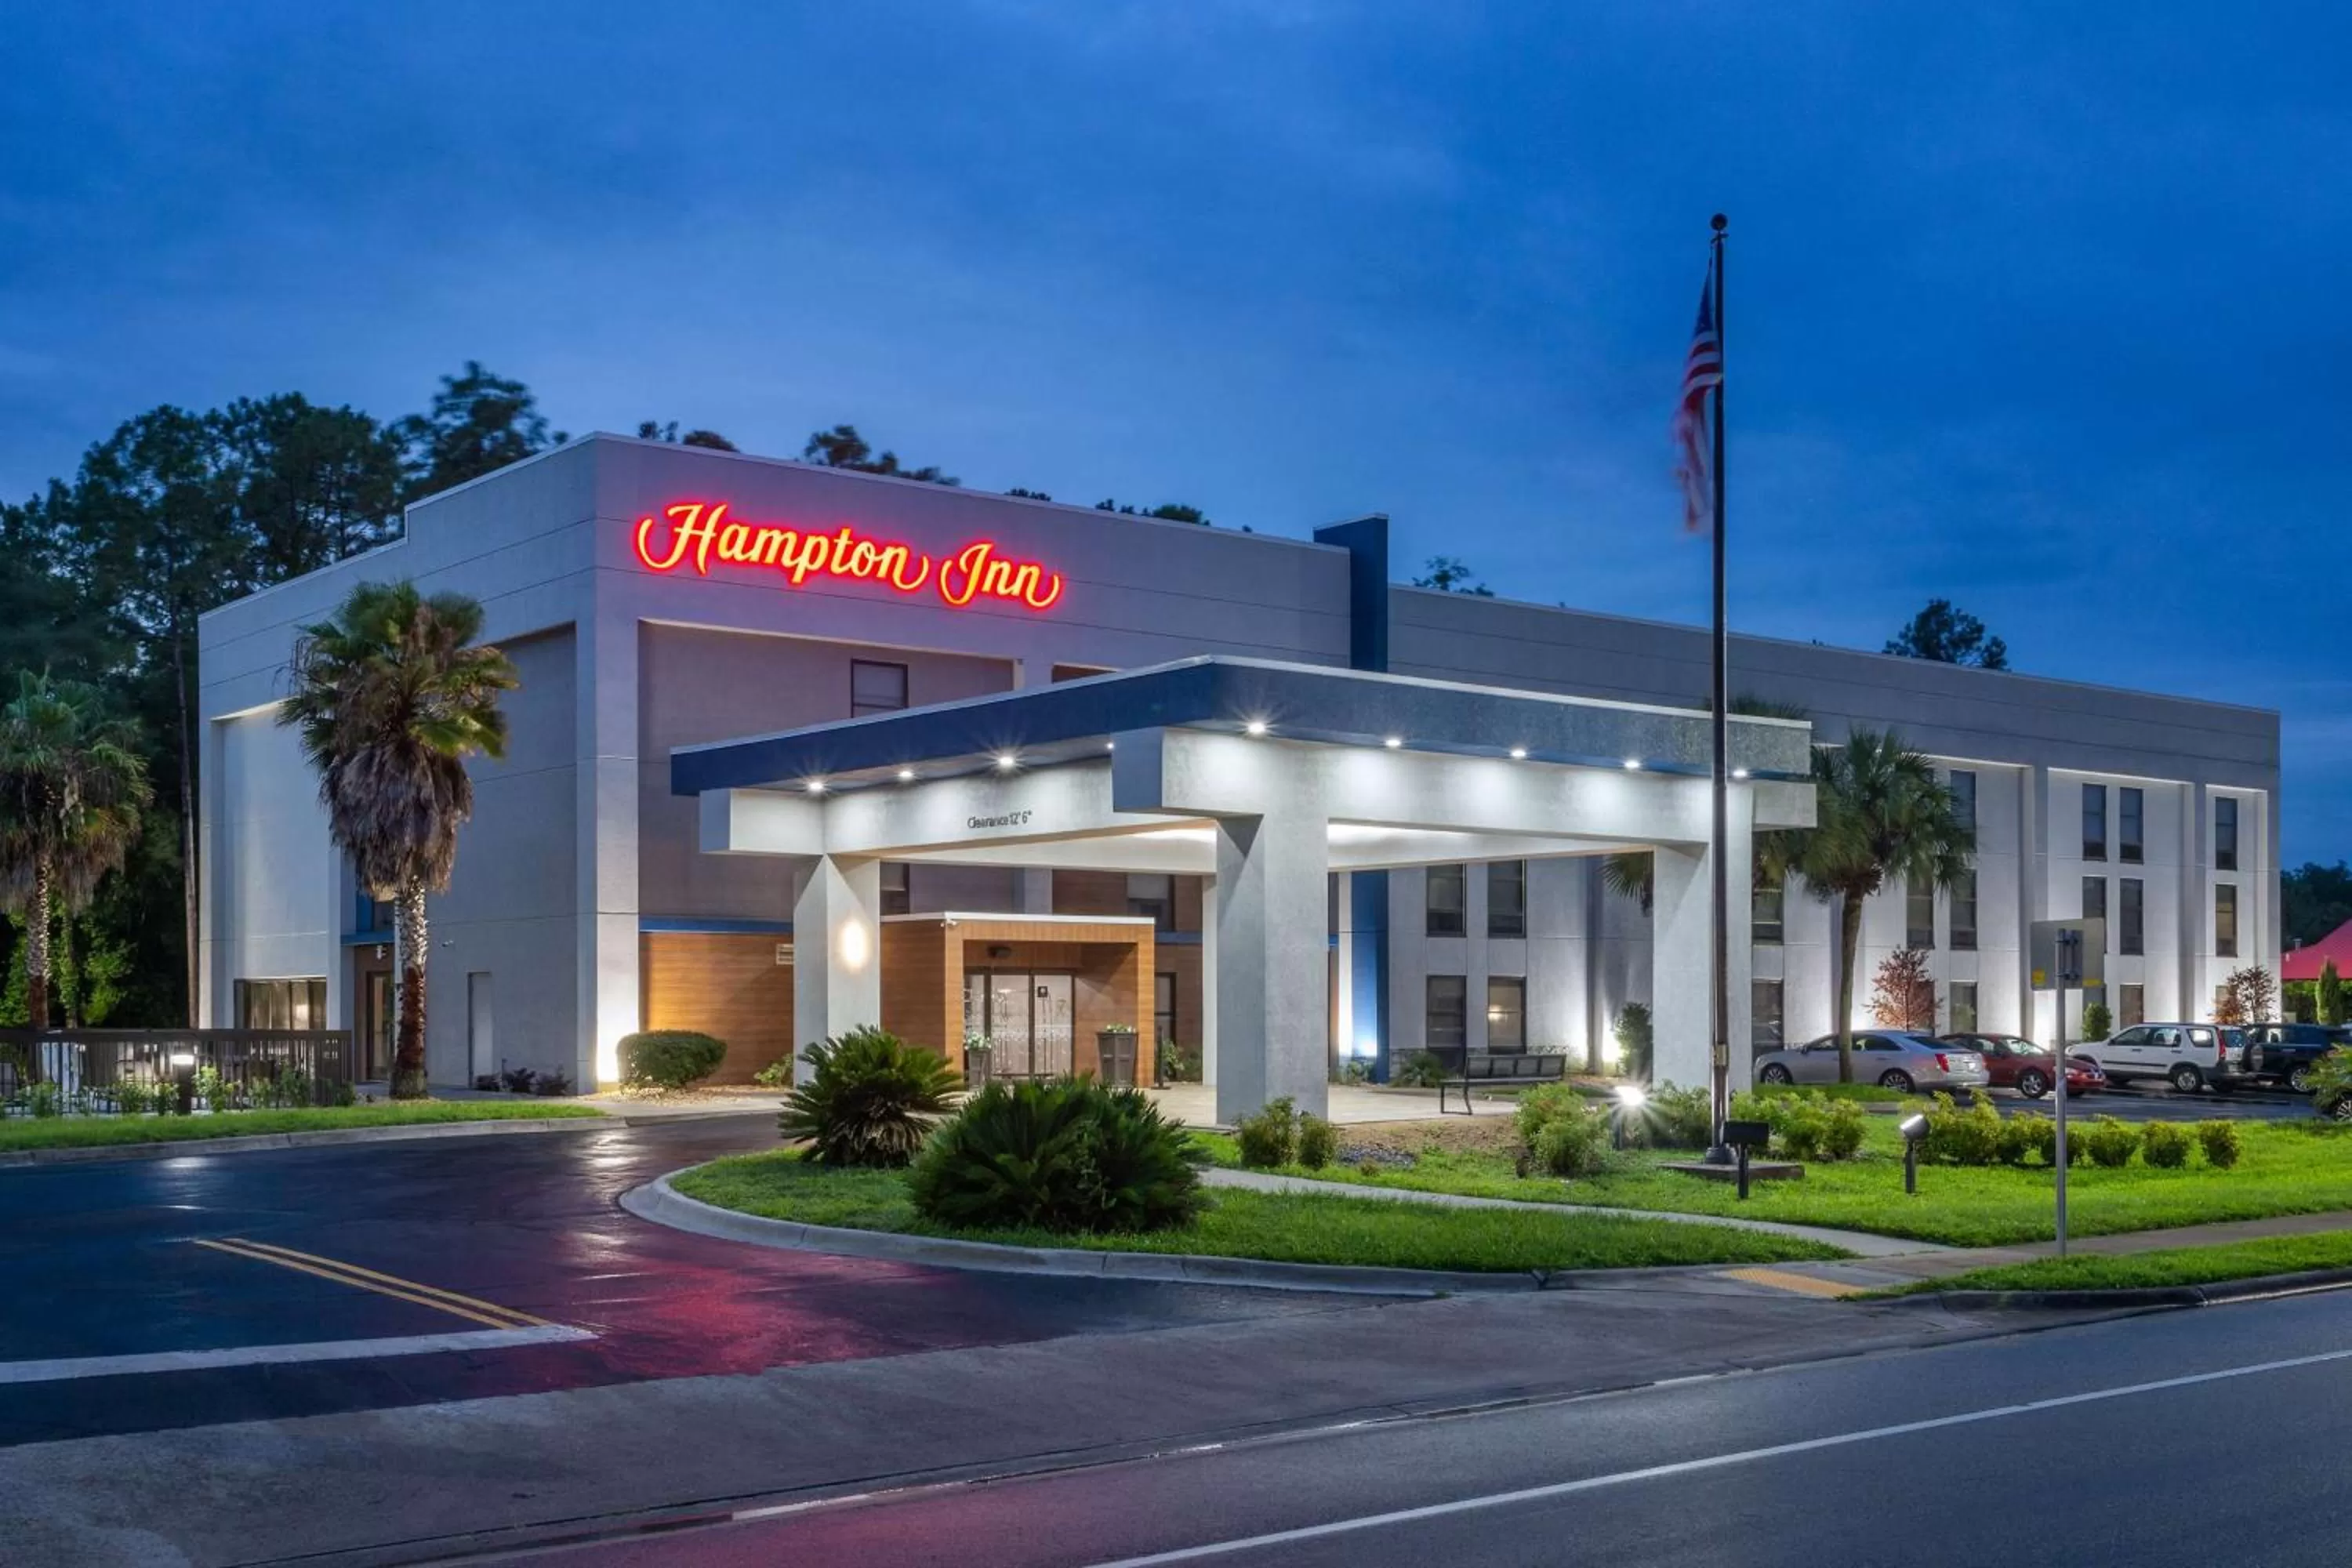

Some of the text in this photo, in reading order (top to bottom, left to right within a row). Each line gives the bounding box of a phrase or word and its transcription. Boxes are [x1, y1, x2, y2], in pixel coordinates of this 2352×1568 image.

[637, 503, 1061, 608] Hampton Inn
[967, 815, 1008, 829] Clearance
